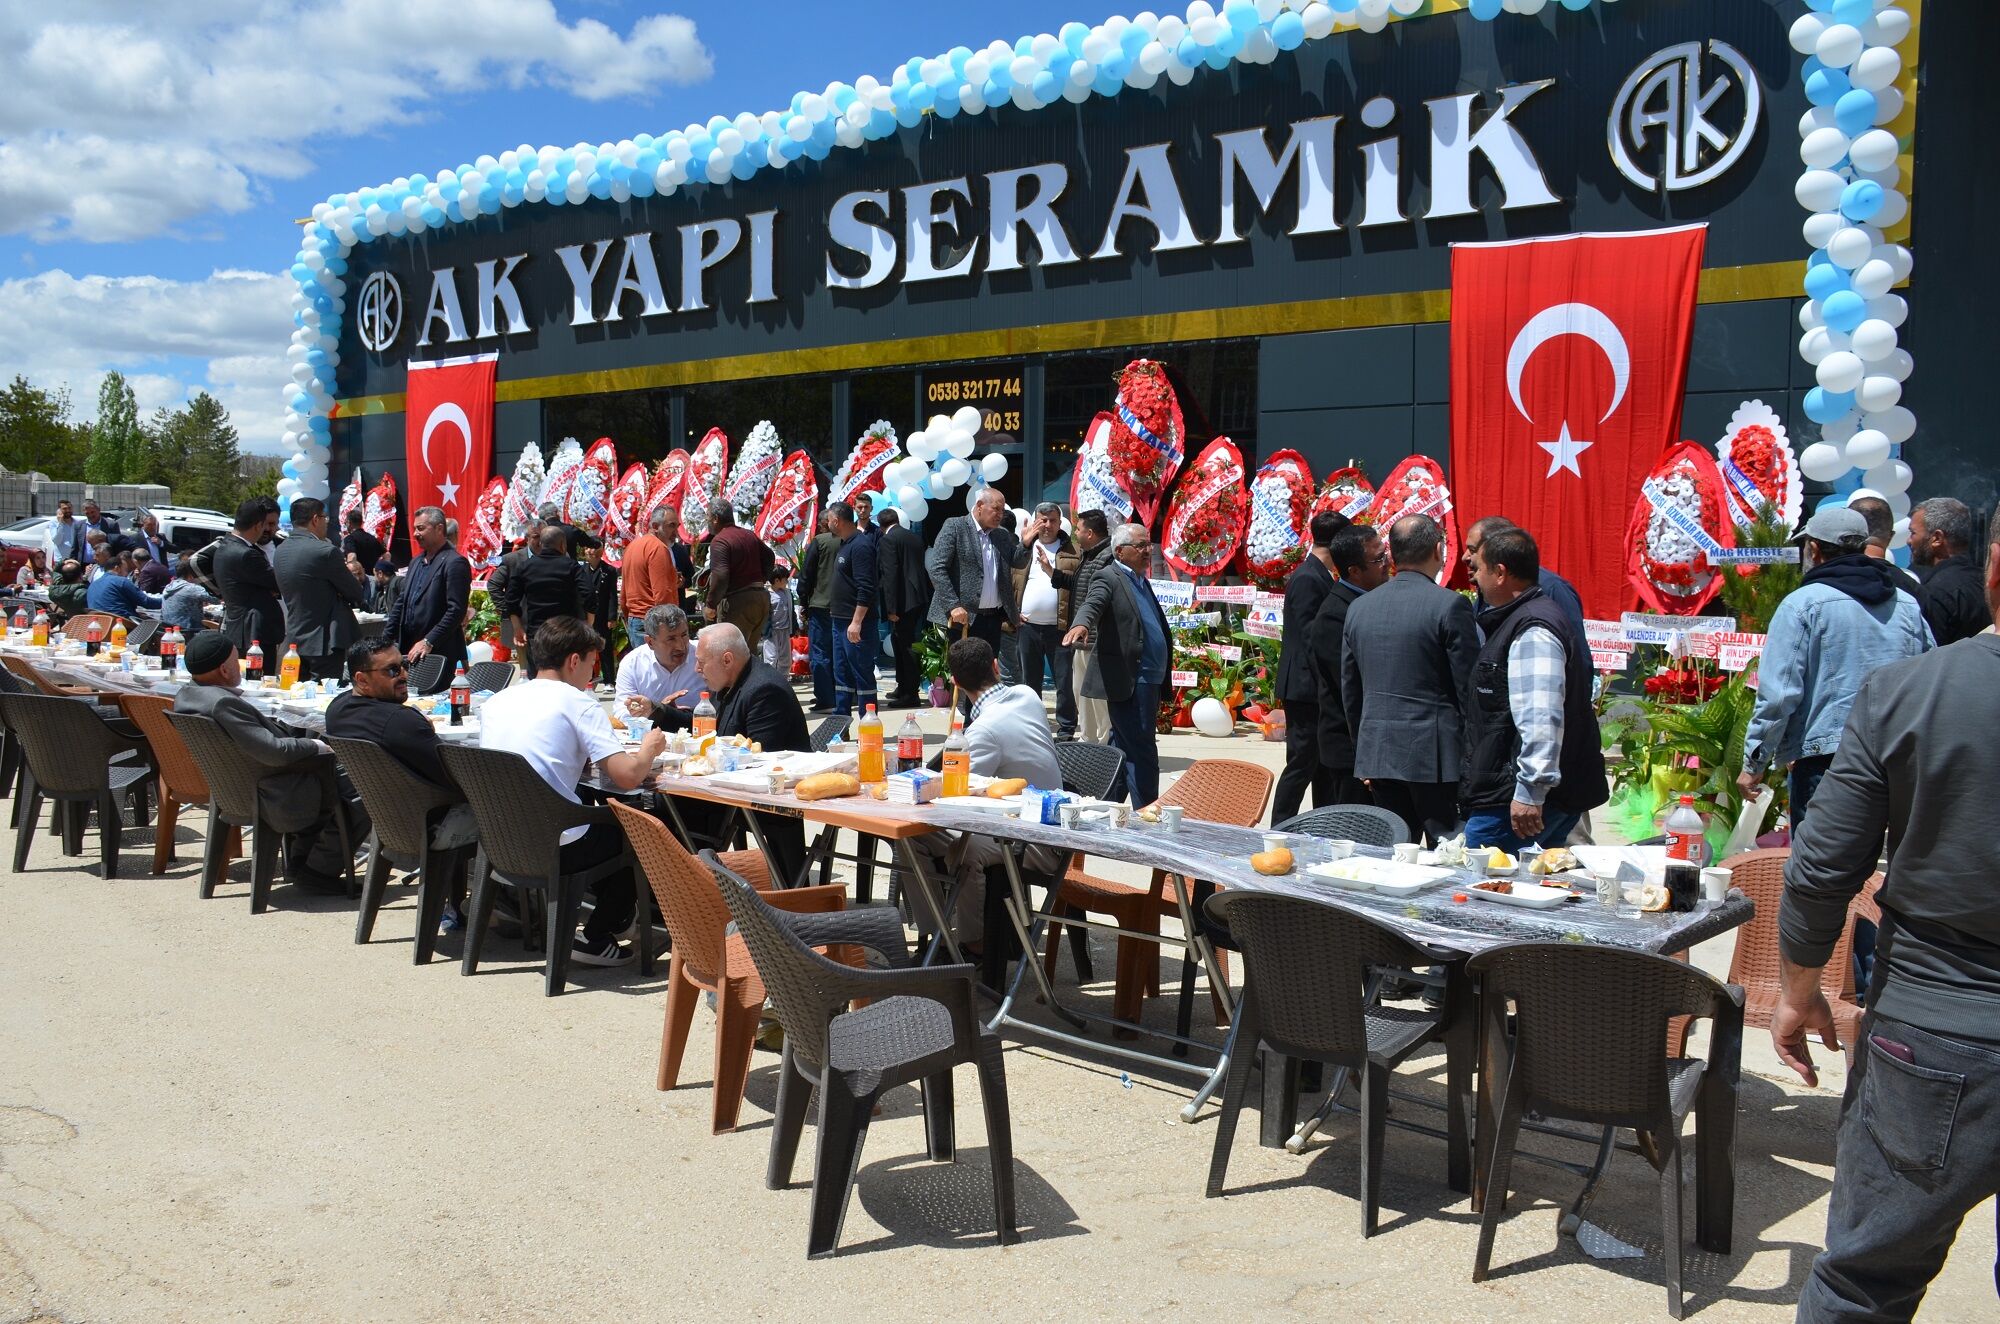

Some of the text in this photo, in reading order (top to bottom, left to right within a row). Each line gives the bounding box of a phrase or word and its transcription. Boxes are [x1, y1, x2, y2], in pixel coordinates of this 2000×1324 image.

[416, 253, 531, 346] AK
[555, 208, 778, 326] YAPI
[928, 378, 1021, 402] 0538 321 77 44
[984, 411, 1020, 431] 40 33
[1138, 424, 1177, 459] YAPI
[870, 448, 895, 468] GRUP
[1737, 548, 1783, 557] KERESTE
[1626, 630, 1656, 640] KALENDER
